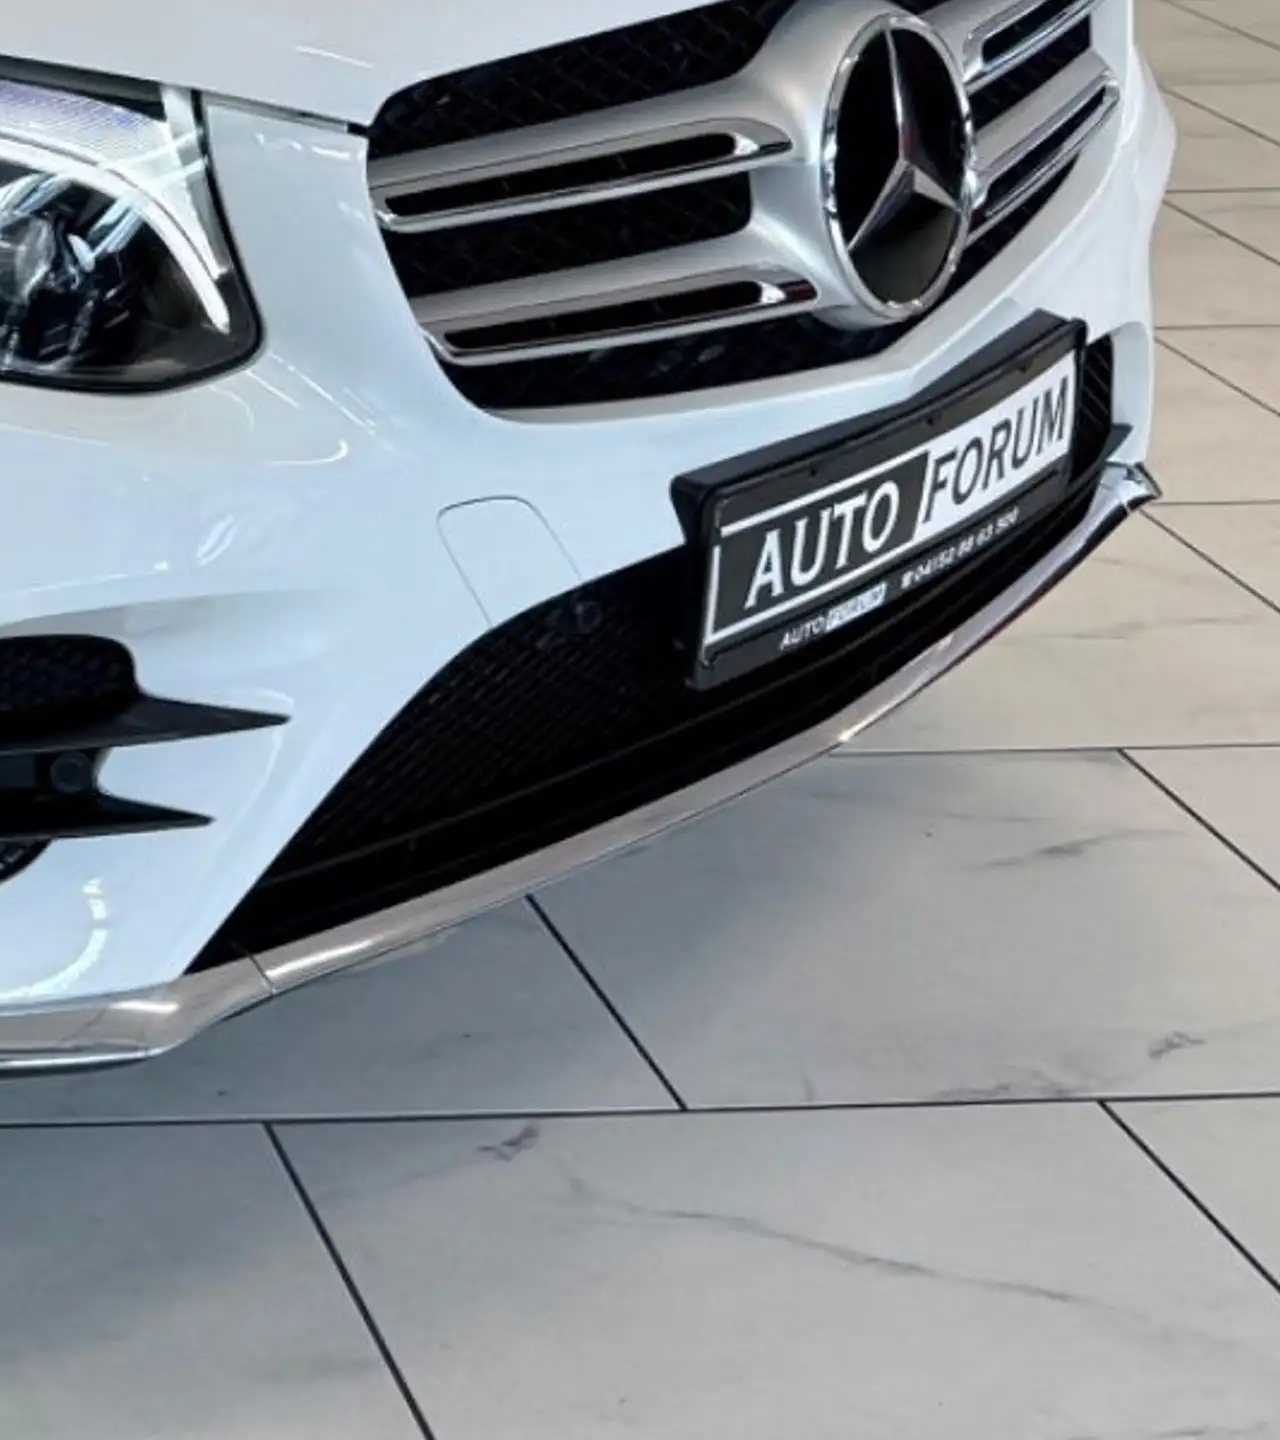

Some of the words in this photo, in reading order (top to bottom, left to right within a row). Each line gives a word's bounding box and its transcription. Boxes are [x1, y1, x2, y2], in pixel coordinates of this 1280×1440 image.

[743, 480, 901, 611] AUTO
[922, 374, 1069, 524] FORUM
[779, 616, 826, 651] AUTO
